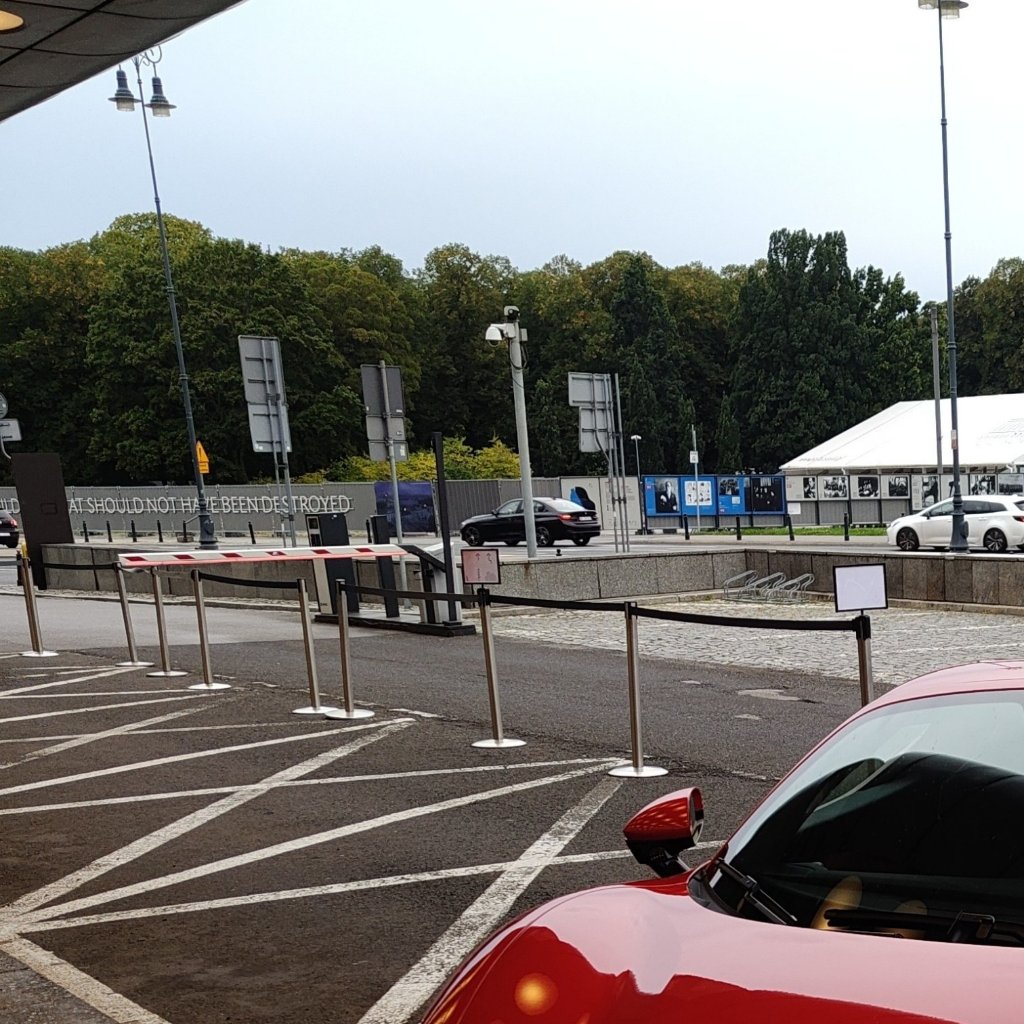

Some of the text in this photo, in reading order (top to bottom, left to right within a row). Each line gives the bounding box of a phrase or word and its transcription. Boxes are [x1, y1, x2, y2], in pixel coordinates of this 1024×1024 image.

[0, 497, 21, 514] LD
[69, 497, 84, 514] AT
[87, 496, 144, 514] SHOULD
[147, 496, 176, 514] NOT
[221, 495, 259, 514] BEEN
[261, 494, 350, 514] DESTROYED
